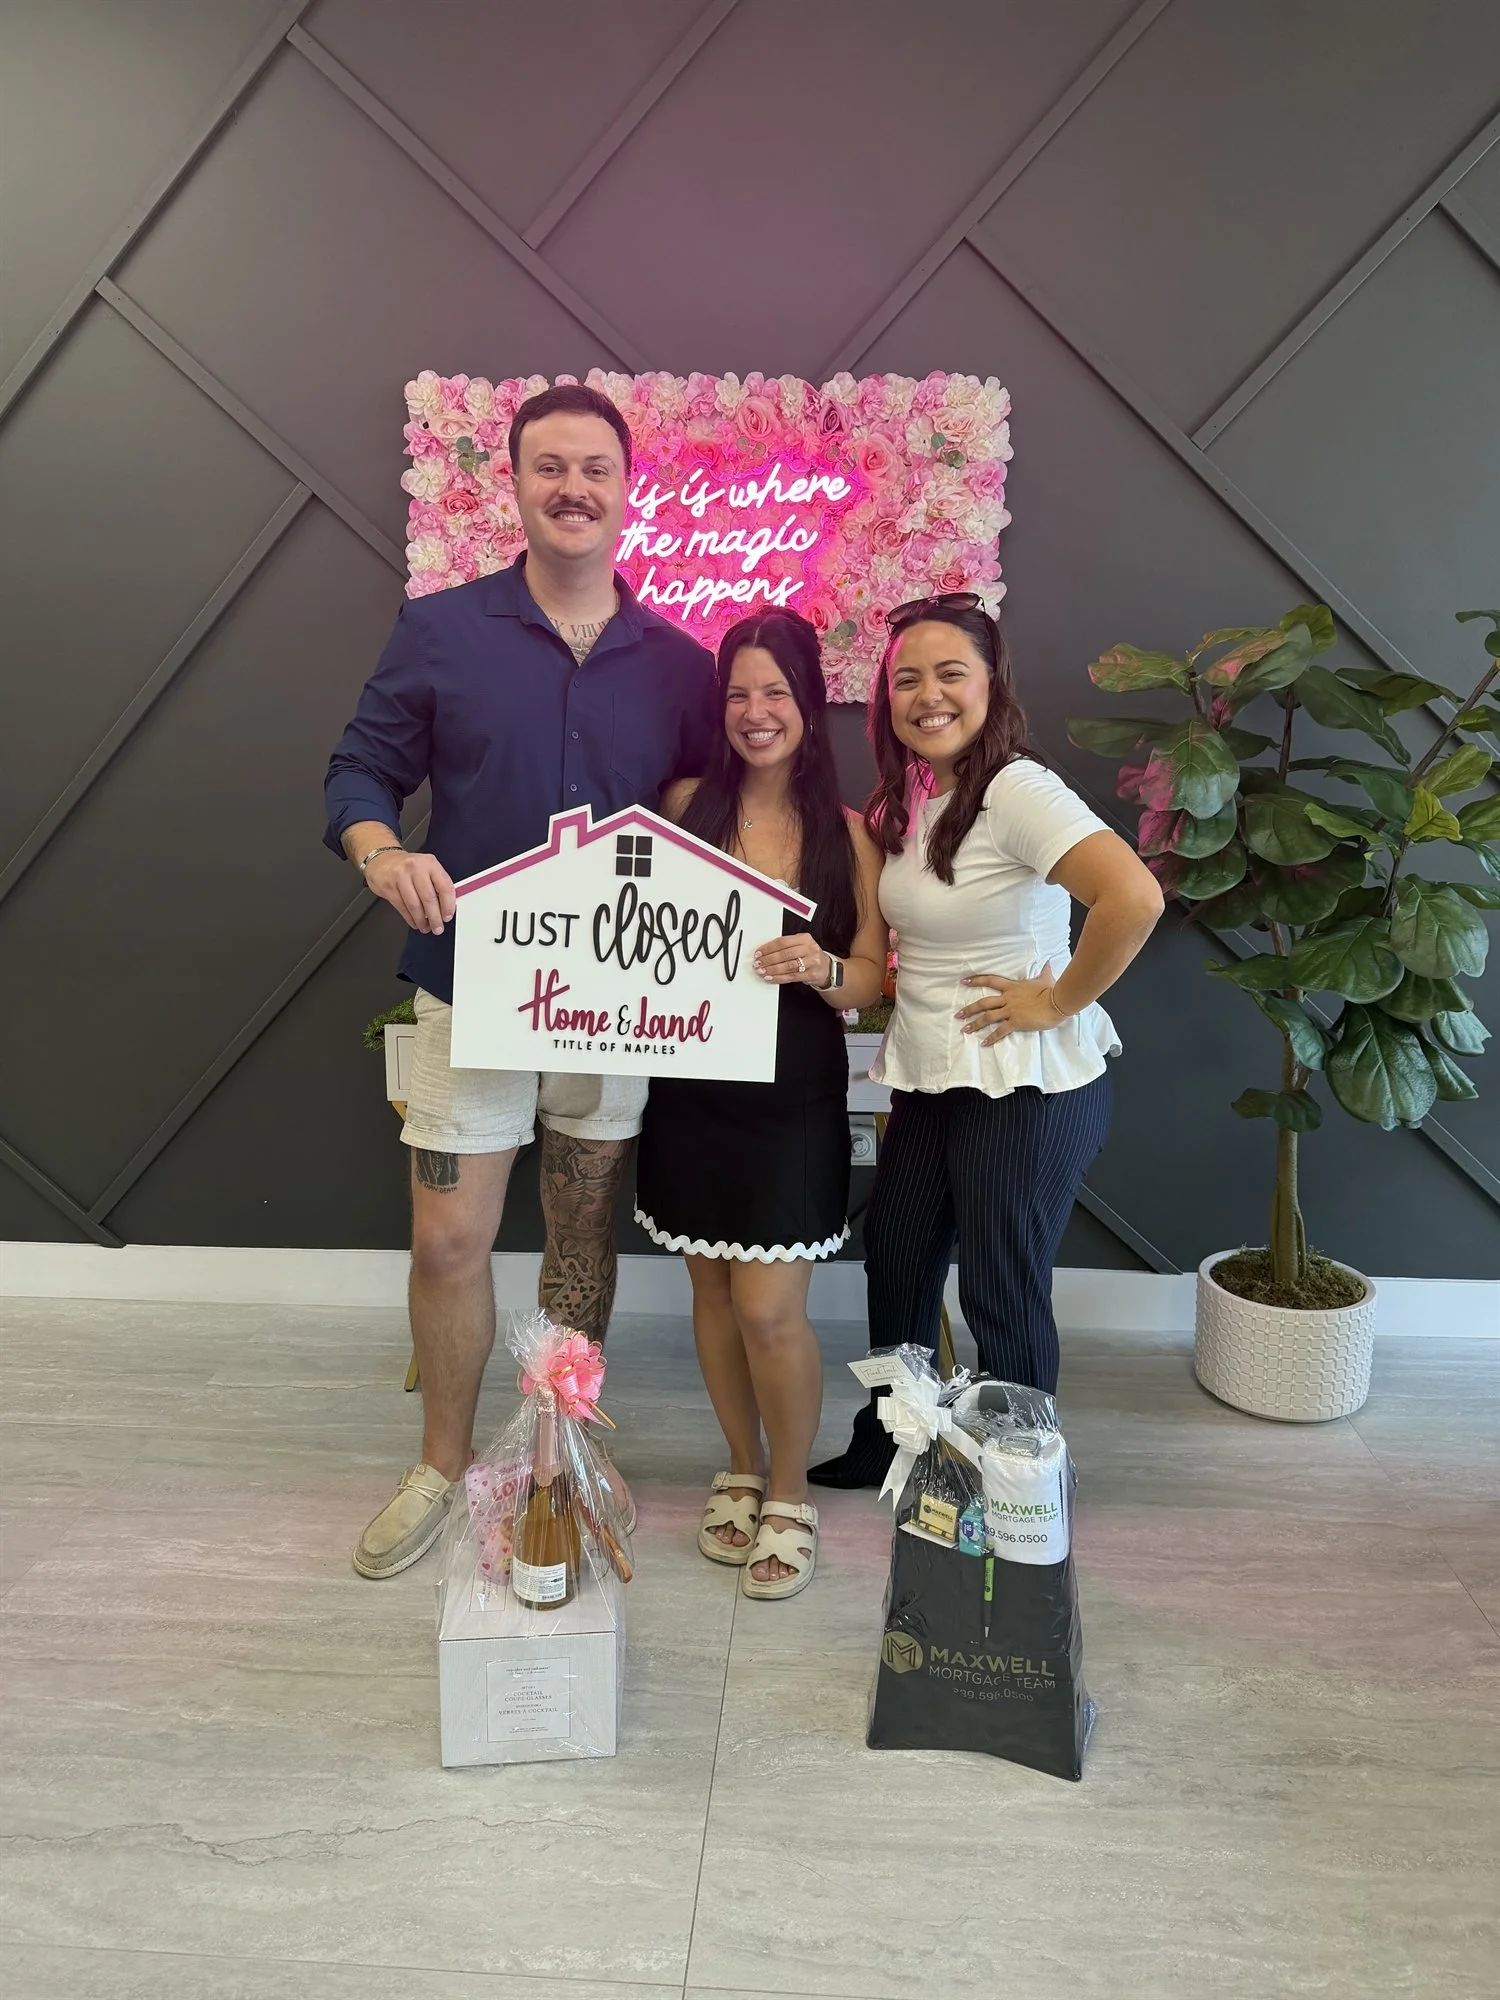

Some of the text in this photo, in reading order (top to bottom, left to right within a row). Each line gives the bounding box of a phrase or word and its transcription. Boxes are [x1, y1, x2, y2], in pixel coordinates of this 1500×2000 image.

[679, 468, 726, 518] is
[729, 462, 852, 509] where
[615, 514, 819, 573] the magic
[636, 565, 805, 621] happens
[494, 881, 744, 985] JUST closed
[517, 968, 714, 1043] Home & Land
[553, 1039, 676, 1055] TITLE OF NAPLES
[990, 1497, 1058, 1515] MAXWELL
[991, 1510, 1059, 1523] MORTGAGE TEAM
[985, 1525, 1048, 1543] 39.596.0500
[928, 1664, 1056, 1689] MORTGAGE TEAM
[930, 1645, 1055, 1677] MAXWELL
